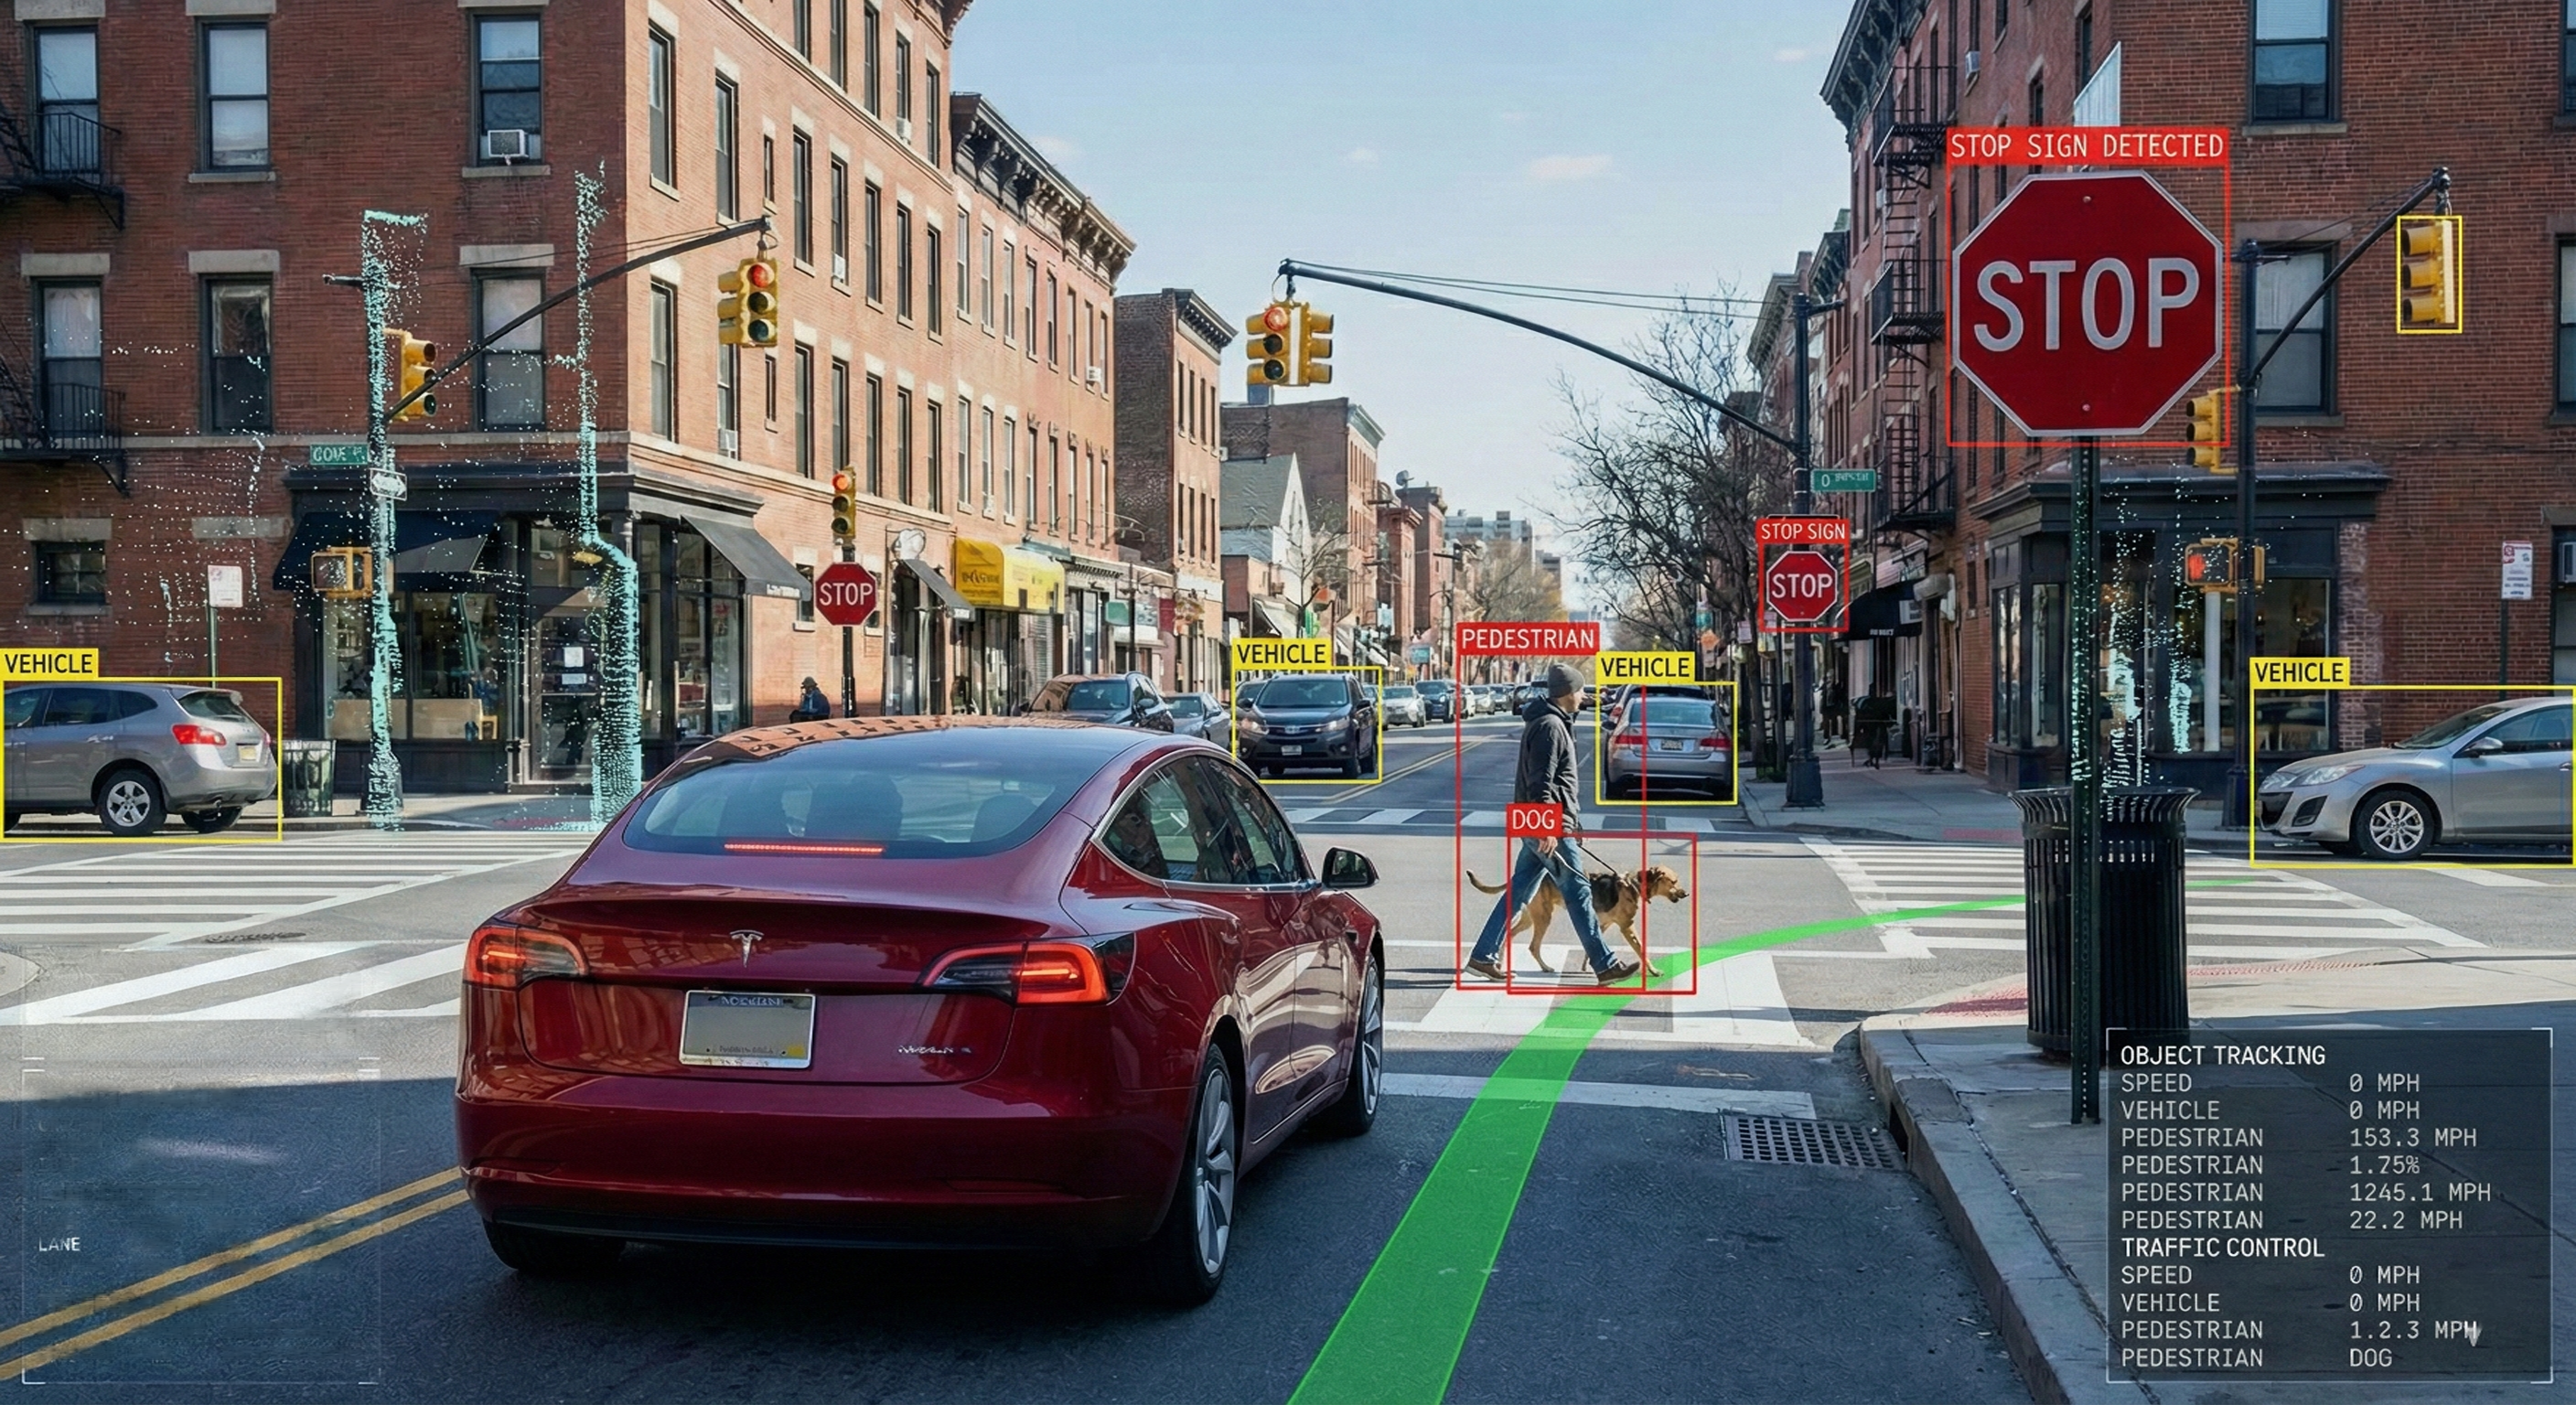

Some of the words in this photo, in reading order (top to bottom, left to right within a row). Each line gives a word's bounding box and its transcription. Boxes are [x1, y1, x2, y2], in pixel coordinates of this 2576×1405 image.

[1973, 257, 2200, 352] STOP
[820, 582, 873, 606] STOP
[1771, 573, 1833, 599] STOP
